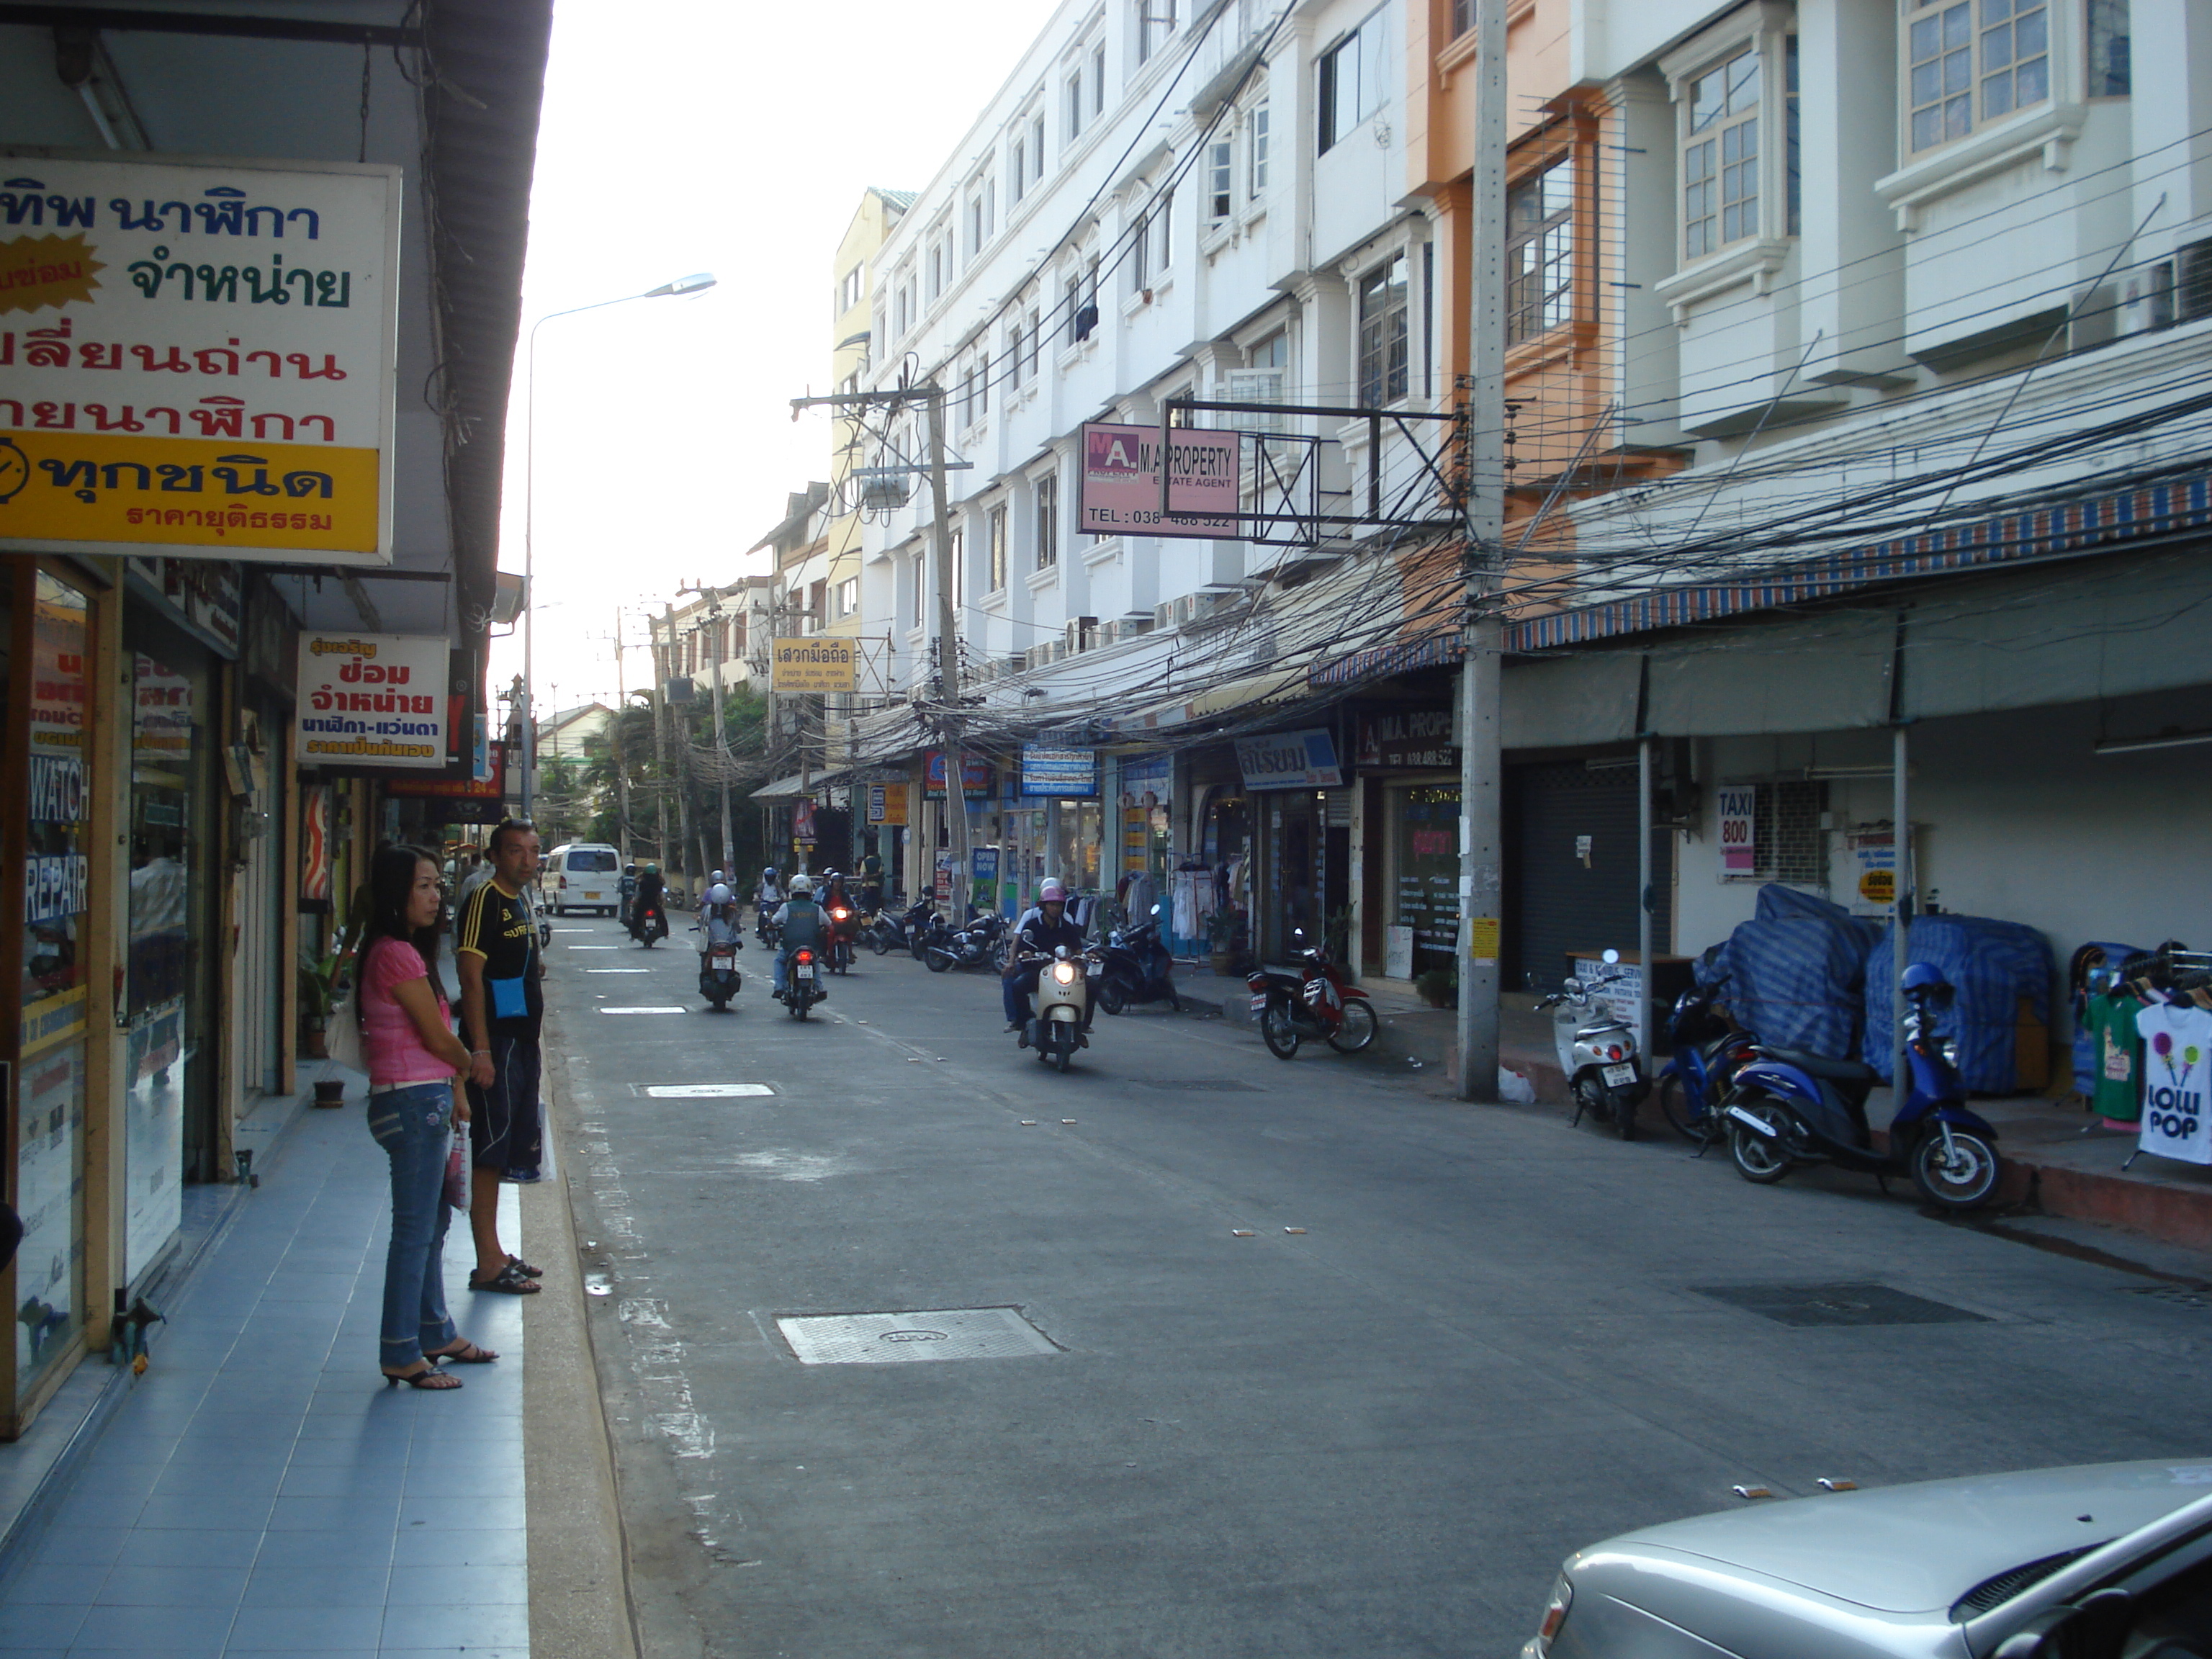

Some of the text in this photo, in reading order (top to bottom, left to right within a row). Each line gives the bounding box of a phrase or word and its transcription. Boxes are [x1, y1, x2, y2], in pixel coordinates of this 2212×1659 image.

[109, 186, 319, 240] นาฬิกา
[127, 246, 351, 308] จำหน่าย
[37, 454, 334, 503] ทุกชนิด
[1153, 477, 1231, 488] ETATE AGENT
[127, 504, 332, 536] ราคายุติธรรม
[339, 657, 410, 685] ซ่อม
[310, 684, 433, 714] จำหน่าย
[307, 737, 435, 757] ราคาเป็นกันเอง
[29, 755, 91, 822] WATCH
[1720, 793, 1752, 816] TAXI
[1723, 819, 1747, 843] 800
[976, 852, 996, 861] OPEN
[976, 862, 994, 872] NOW
[24, 855, 88, 924] REPAIR
[2150, 1112, 2198, 1140] POP
